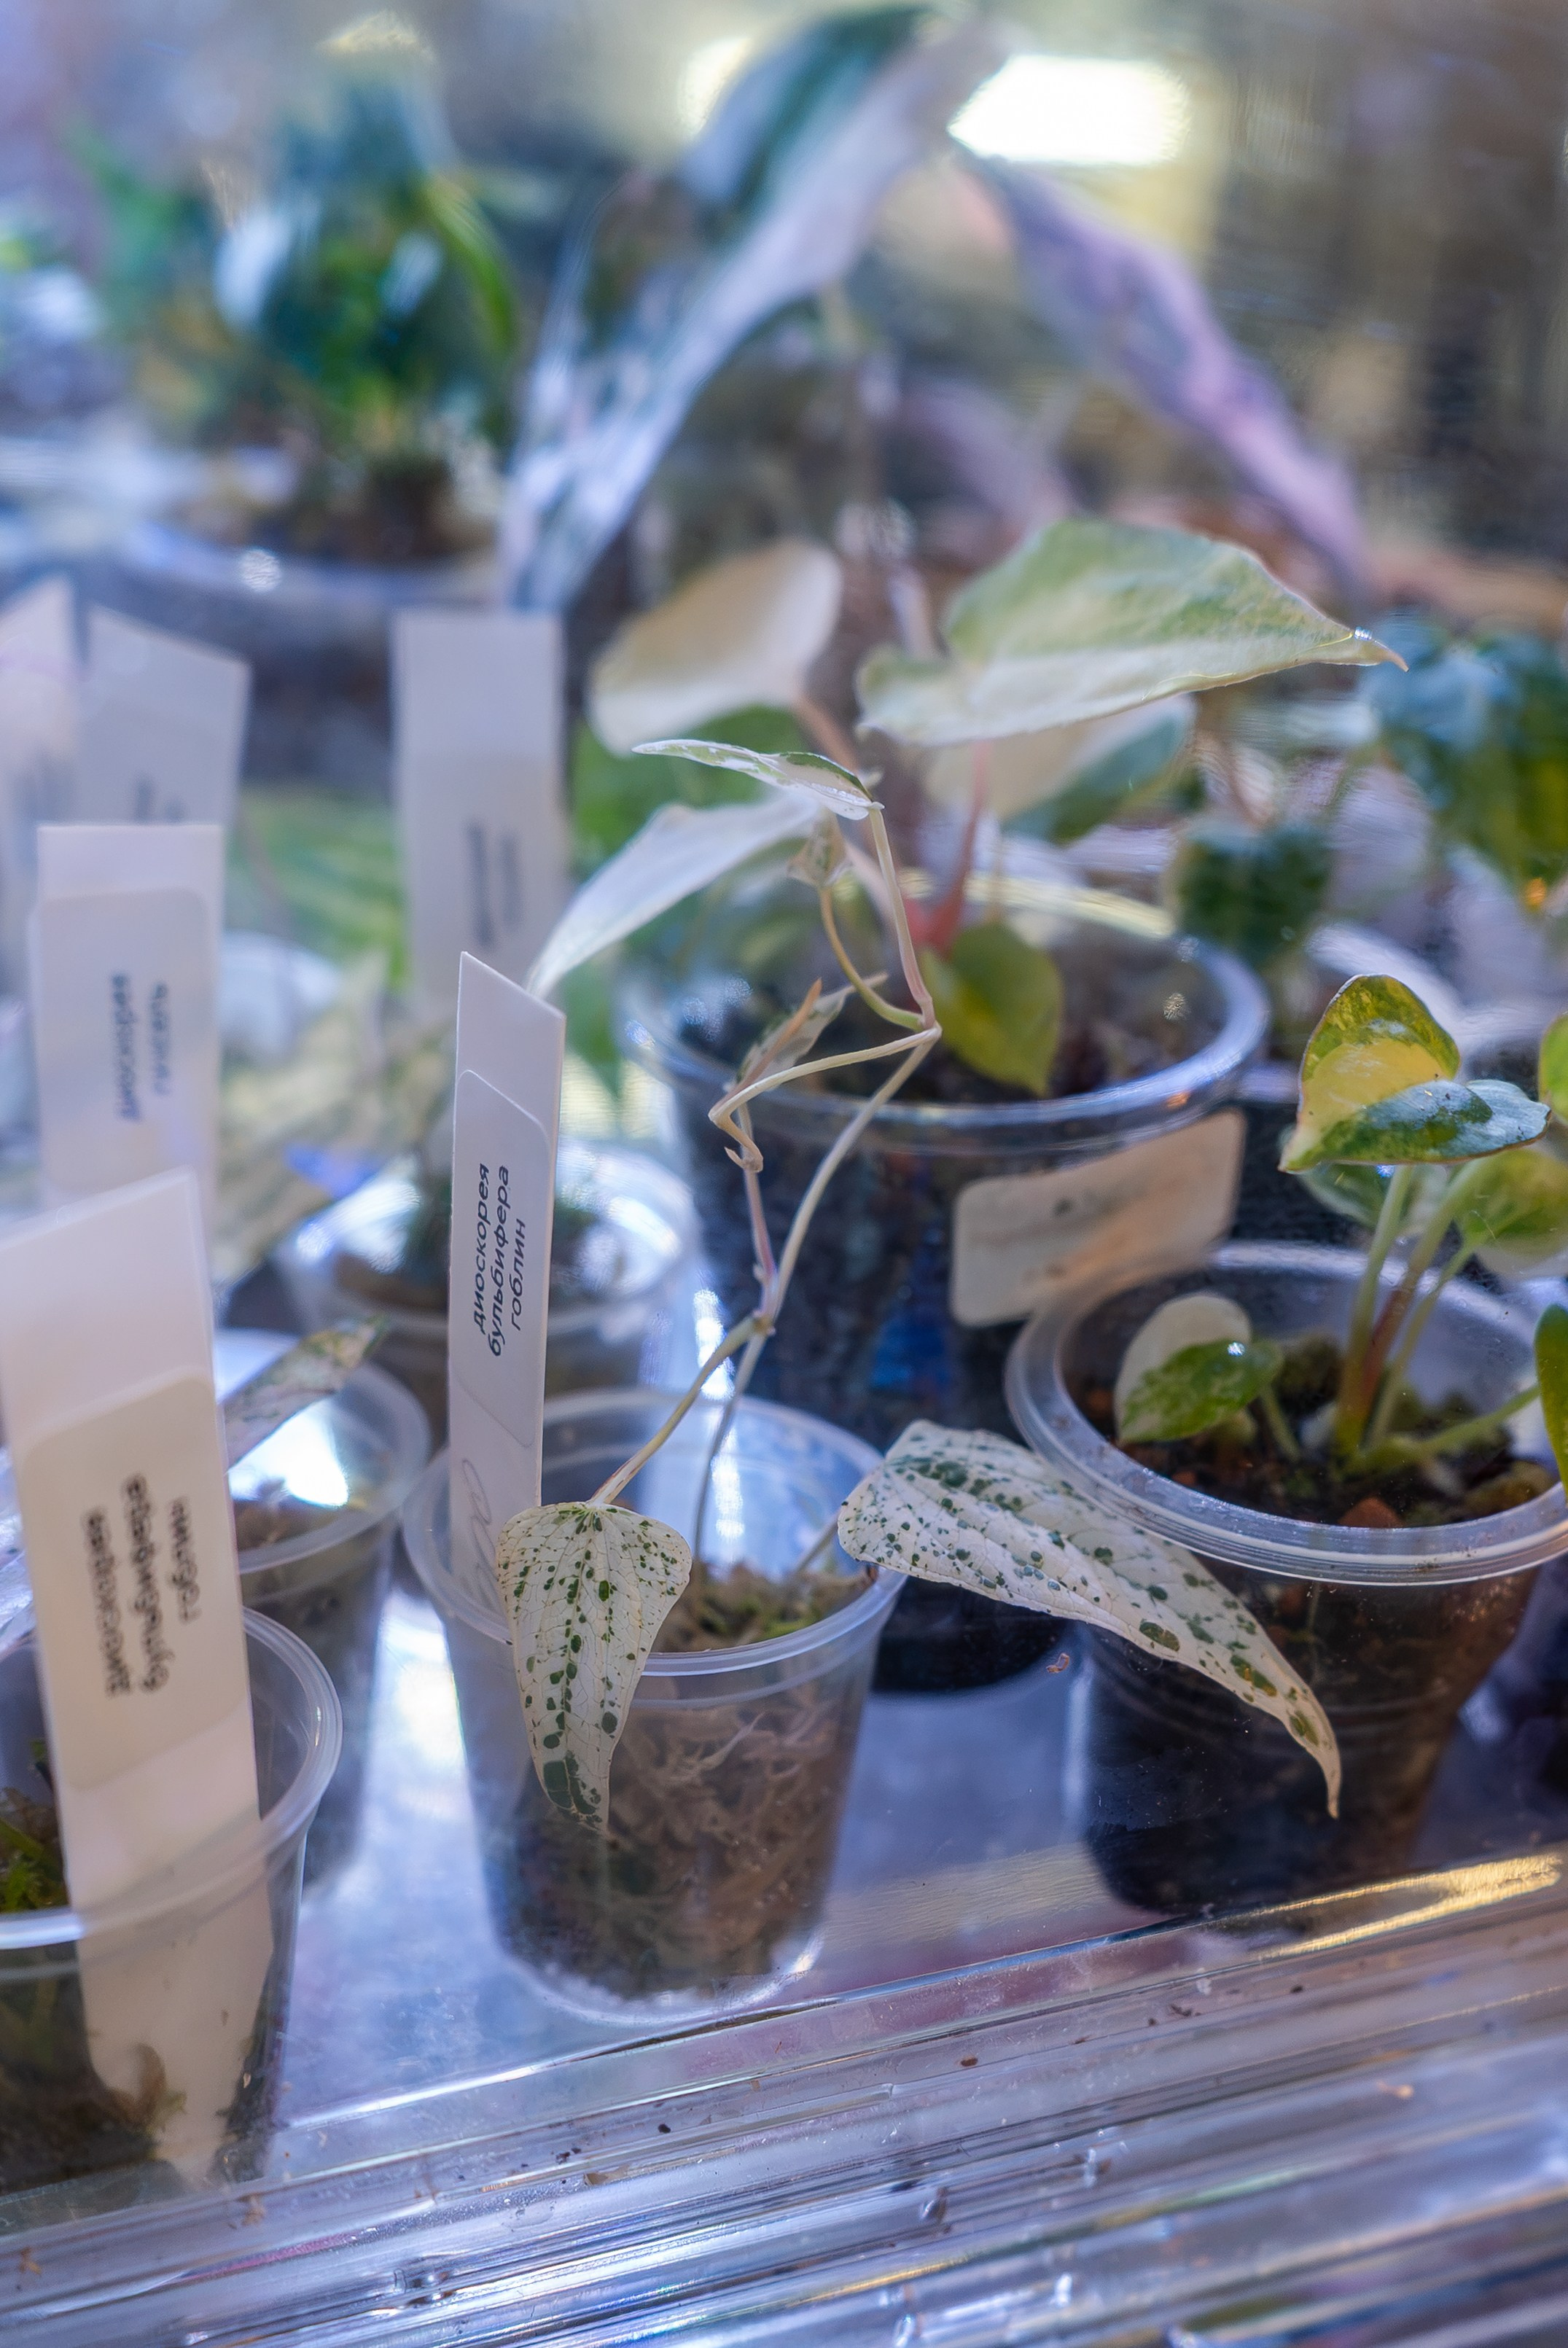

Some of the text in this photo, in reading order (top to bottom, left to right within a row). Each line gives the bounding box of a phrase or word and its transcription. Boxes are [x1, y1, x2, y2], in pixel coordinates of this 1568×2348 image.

[474, 1163, 491, 1335] диоскорея
[488, 1165, 511, 1356] бульбифера
[510, 1219, 526, 1330] гоблин
